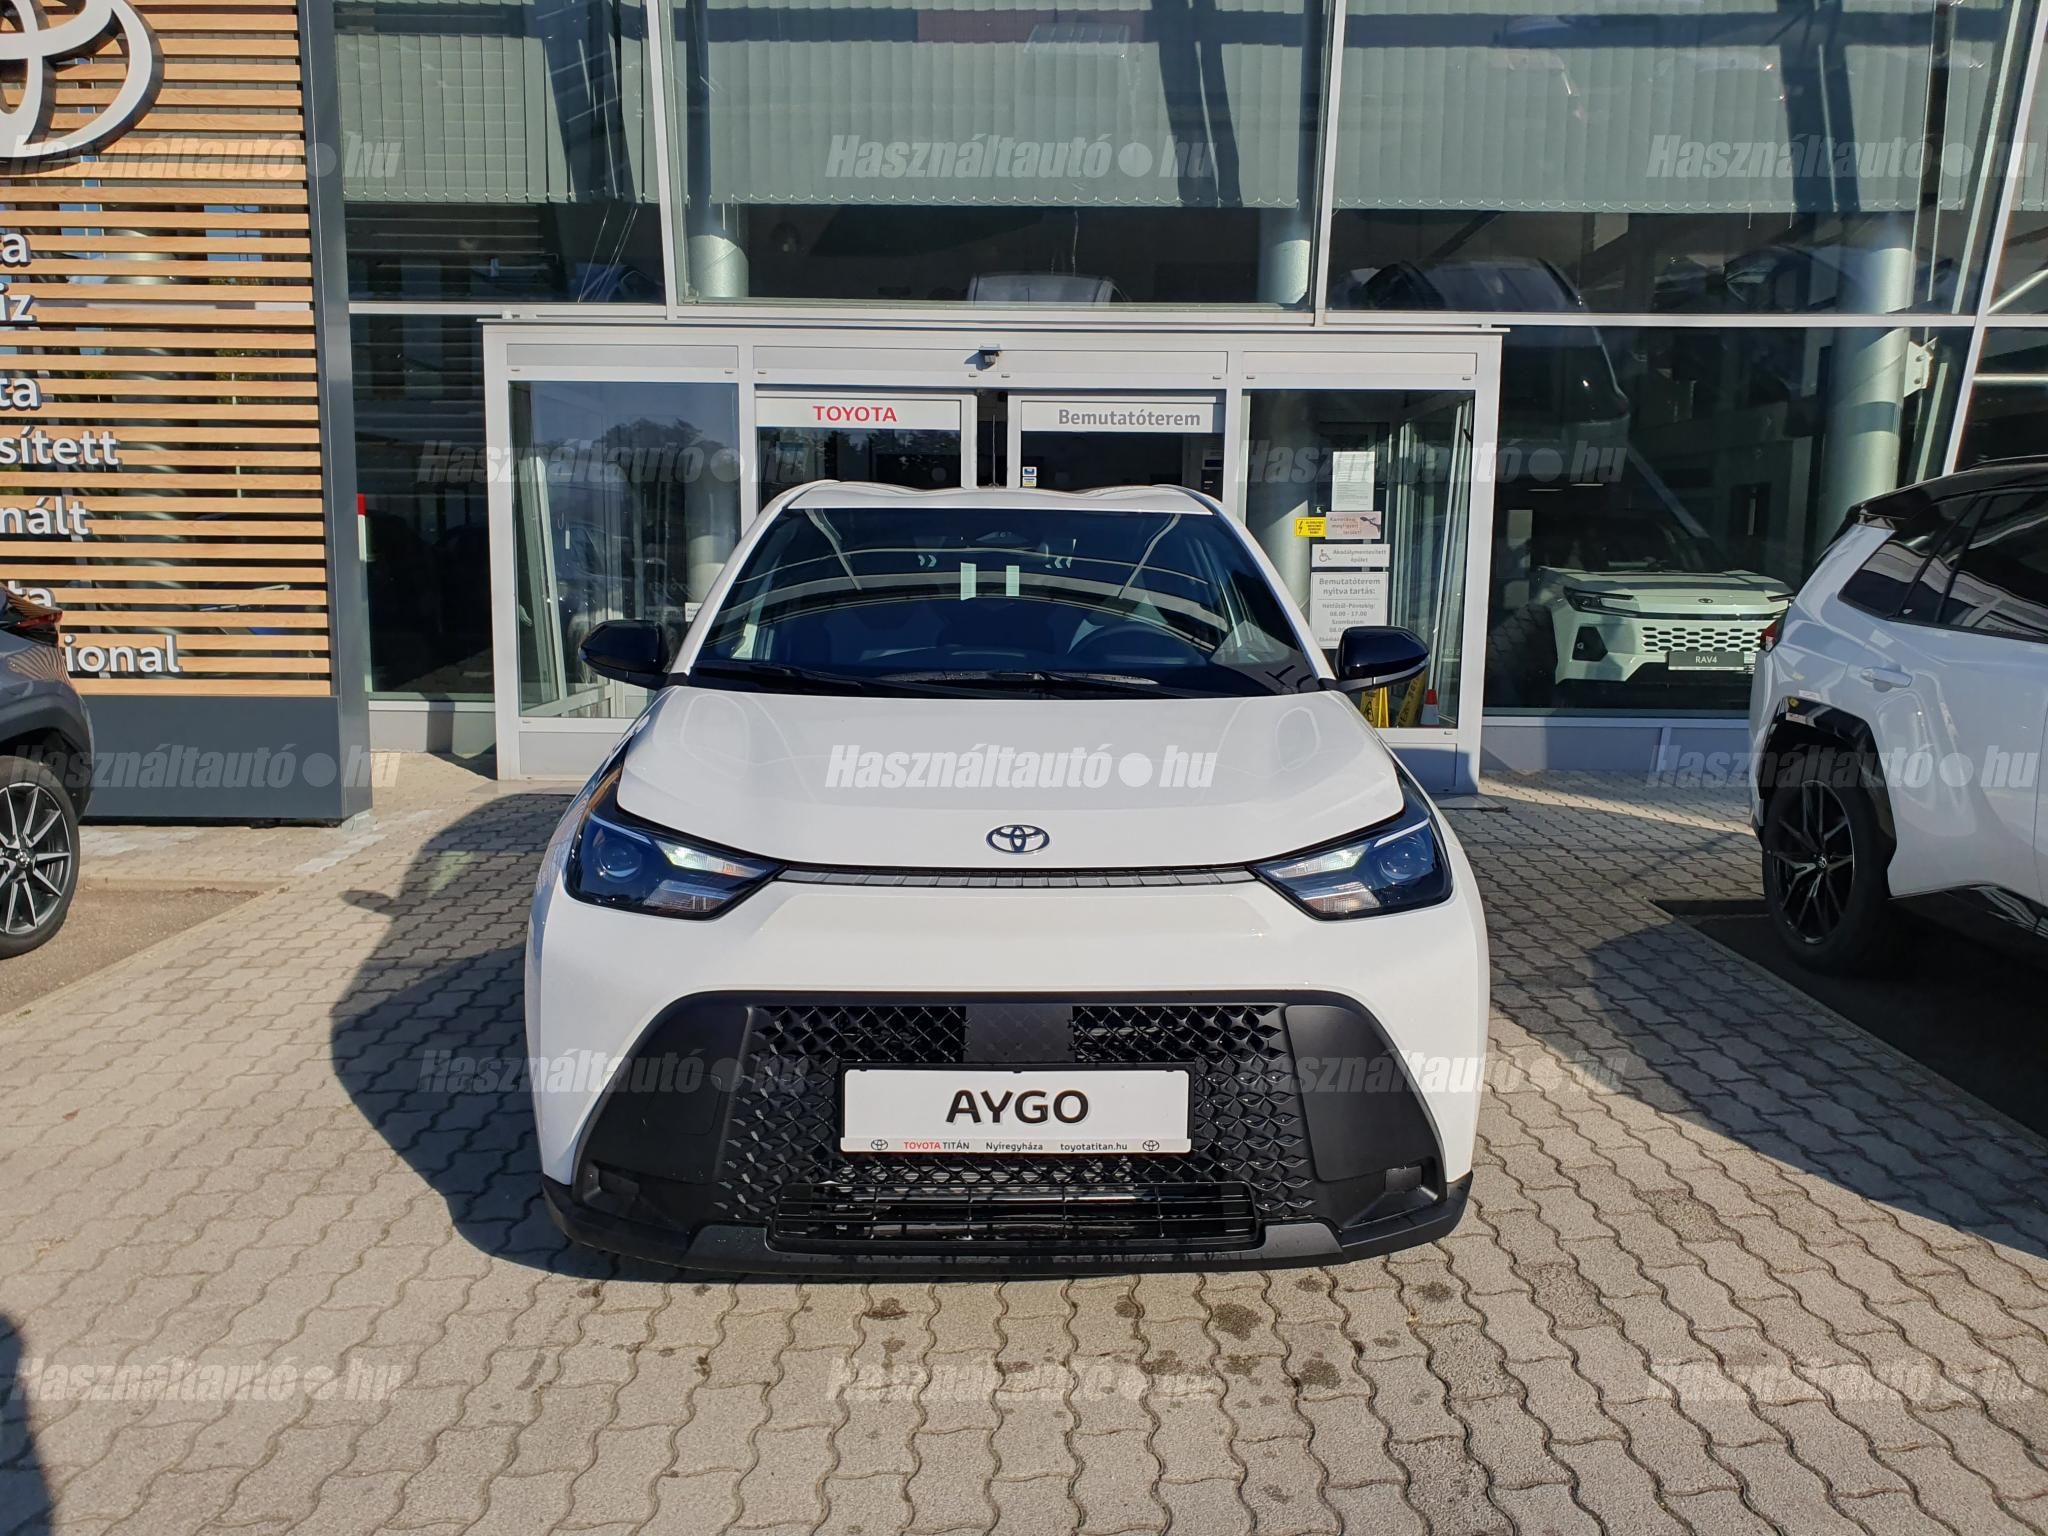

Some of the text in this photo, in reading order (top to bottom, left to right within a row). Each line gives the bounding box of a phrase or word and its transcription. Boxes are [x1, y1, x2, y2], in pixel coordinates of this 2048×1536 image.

[812, 405, 898, 423] TOYOTA
[1057, 408, 1201, 427] Bemutatóterem
[0, 426, 120, 465] sített
[0, 496, 90, 535] nált
[1319, 577, 1381, 585] Bemutatóterem
[1323, 587, 1348, 596] nyitva
[1695, 655, 1718, 664] RAV4
[945, 1089, 1089, 1124] AYGO
[903, 1140, 1128, 1152] TOYOTA TITÁN Nyíregyháza toyotatitan.hu
